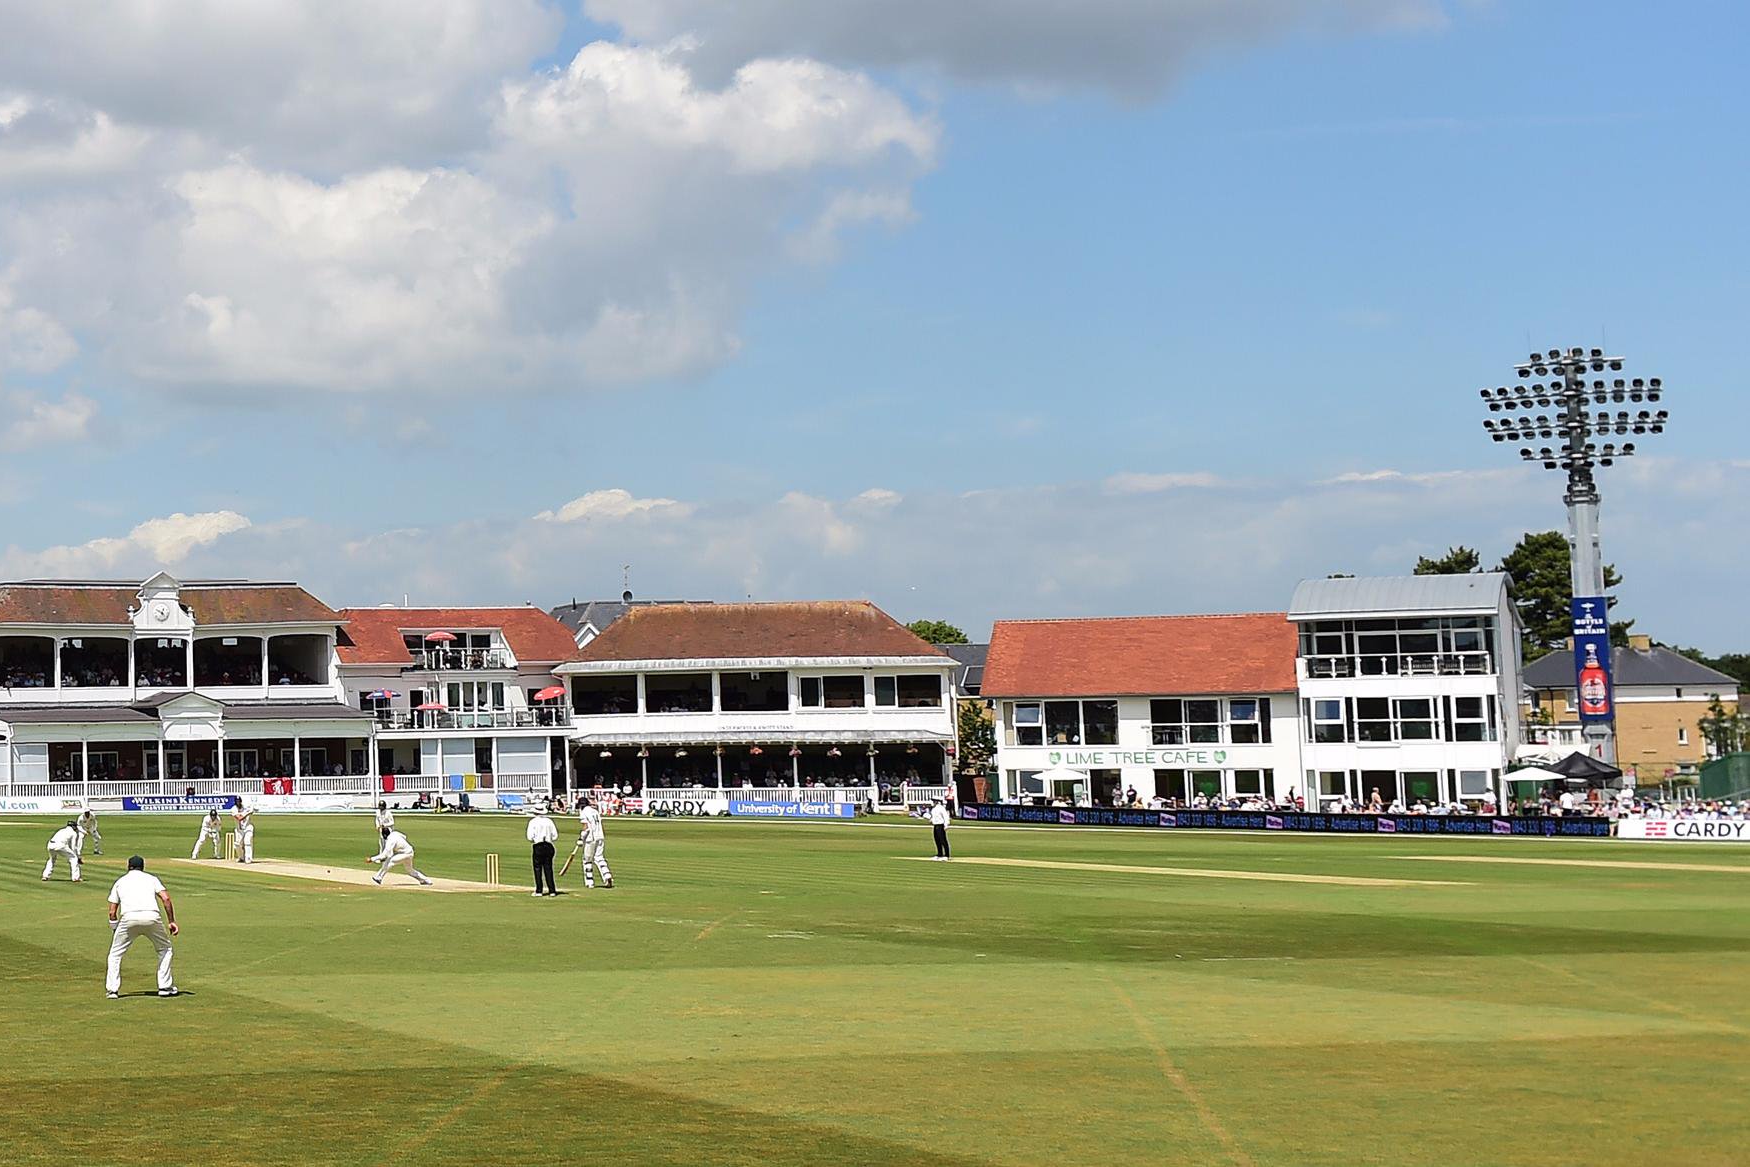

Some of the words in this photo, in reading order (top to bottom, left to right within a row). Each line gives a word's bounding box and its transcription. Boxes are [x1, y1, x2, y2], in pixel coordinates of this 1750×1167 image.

[1066, 752, 1104, 764] LIME
[1109, 752, 1156, 764] TREE
[1161, 751, 1208, 764] CAFE
[1595, 744, 1602, 758] 1
[179, 796, 227, 804] KENNEDY
[648, 800, 706, 814] CARDY
[737, 804, 785, 816] University
[786, 804, 798, 814] of
[800, 802, 830, 815] Kent
[1674, 822, 1745, 838] CARDY
